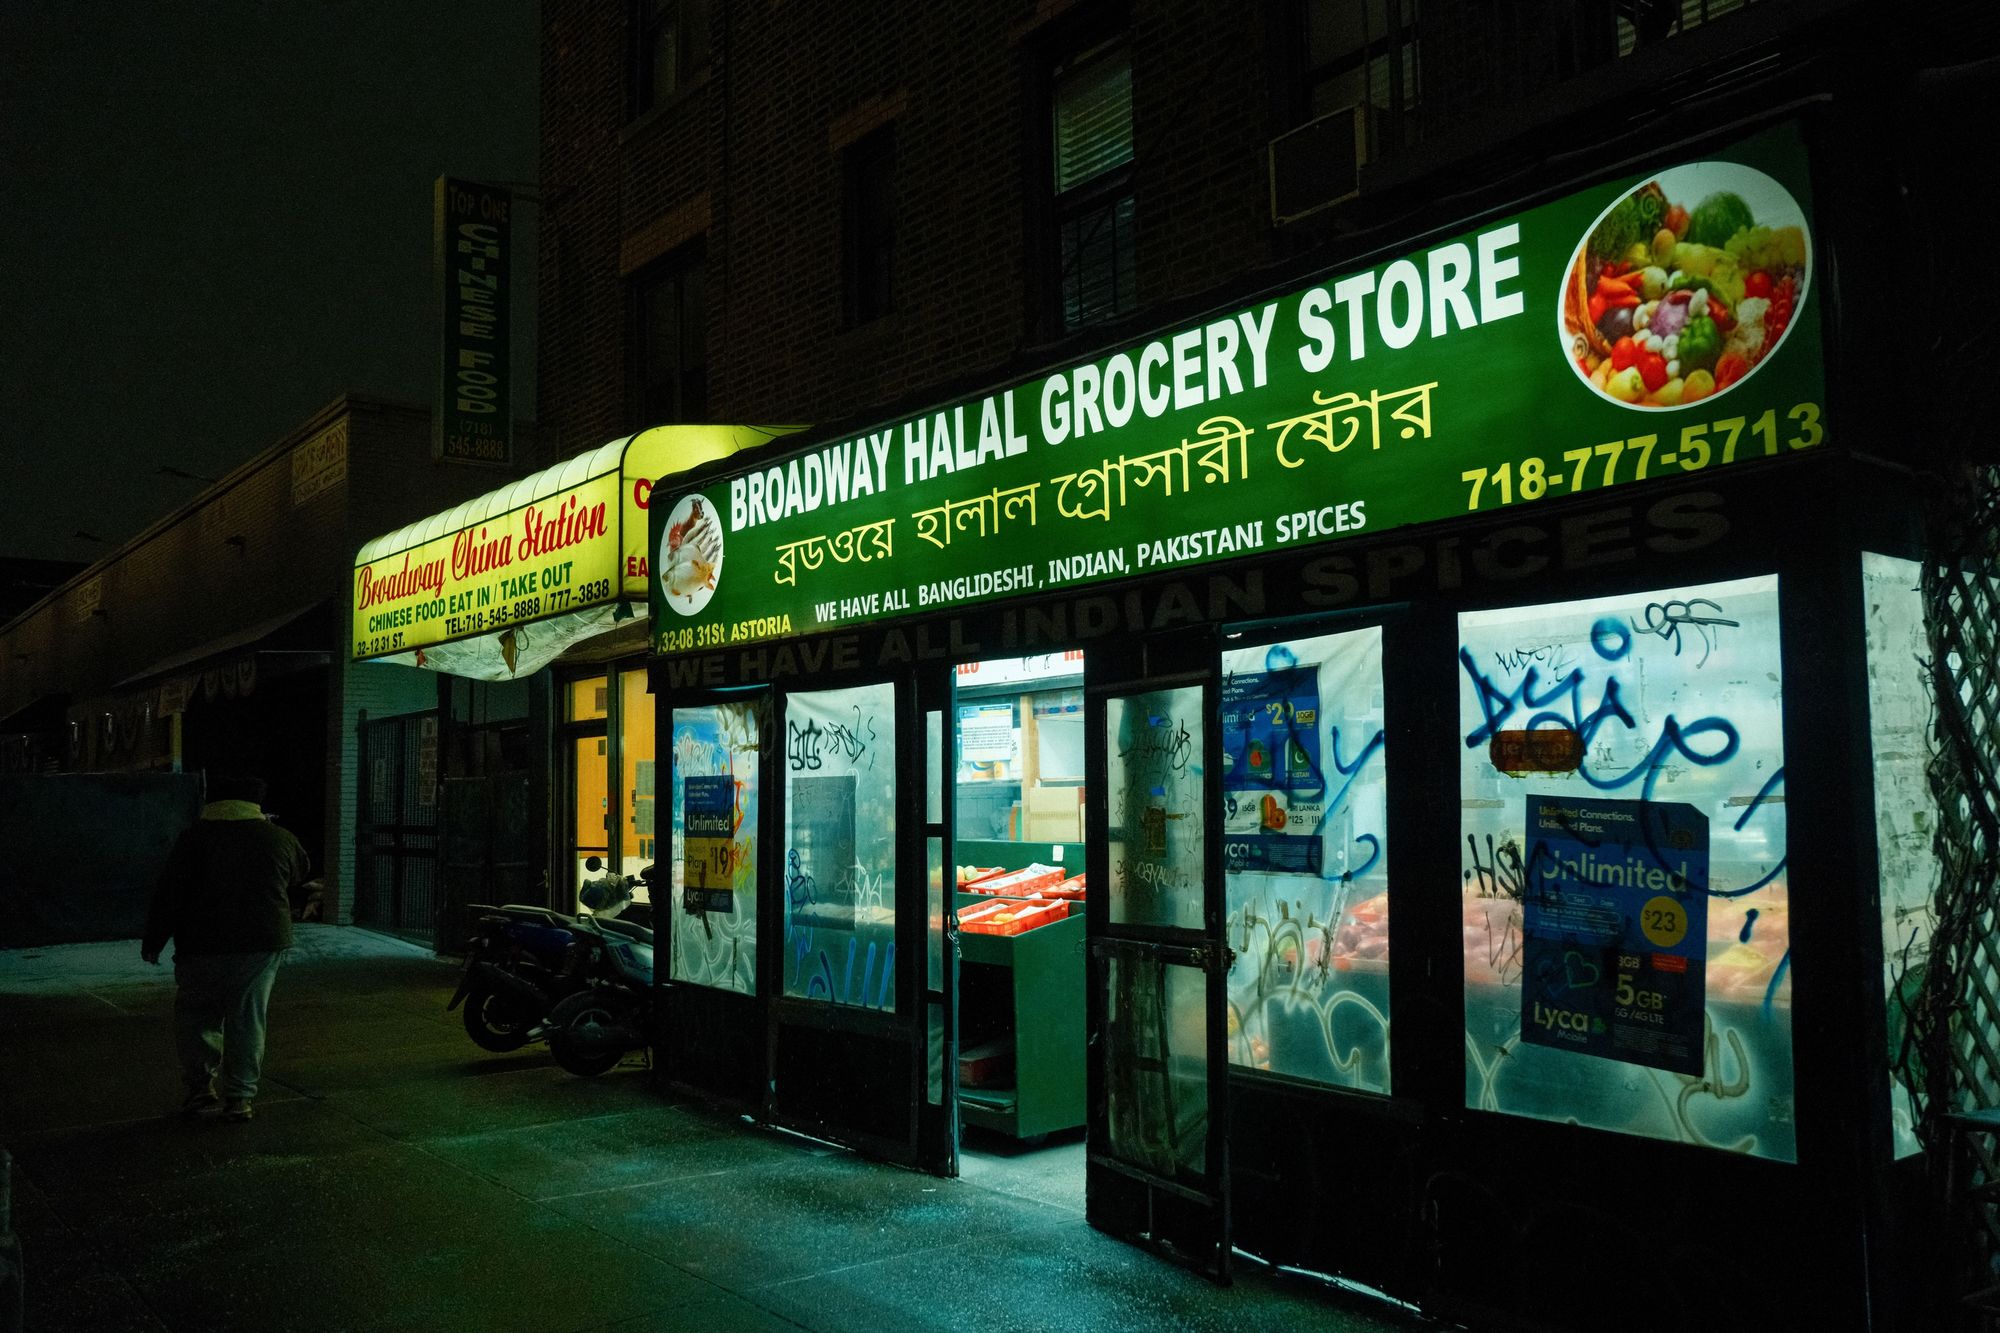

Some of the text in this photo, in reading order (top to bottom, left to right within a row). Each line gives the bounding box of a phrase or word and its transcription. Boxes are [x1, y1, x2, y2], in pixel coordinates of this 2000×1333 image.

[456, 222, 500, 414] CHINESE FOOD
[731, 222, 1525, 532] BROADWAY HALAL GROCERY STORE
[1461, 402, 1824, 511] 718-777-5713
[911, 482, 1041, 551] হালাল
[358, 494, 608, 611] Broadway China Station
[815, 601, 837, 624] WE
[839, 594, 880, 620] HAVE
[883, 588, 911, 613] ALL
[918, 564, 1034, 606] BANGLIDESHI
[1048, 548, 1131, 585] INDIAN,
[1137, 521, 1264, 567] PAKISTANI
[1275, 500, 1367, 543] SPICES
[368, 606, 413, 634] CHINESE
[415, 597, 446, 623] FOOD
[449, 590, 473, 615] EAT
[476, 585, 491, 607] IN
[500, 570, 538, 600] TAKE
[541, 561, 574, 590] OUT
[445, 597, 541, 637] TEL:718-545-8888
[549, 578, 610, 611] 777-3838
[666, 490, 1731, 689] WE HAVE ALL INDIAN SPICES
[730, 614, 792, 642] ASTORIA
[688, 814, 730, 832] Unlimited
[1542, 849, 1688, 892] Unlimited
[1643, 908, 1677, 933] $23
[1534, 1000, 1589, 1033] Lyca
